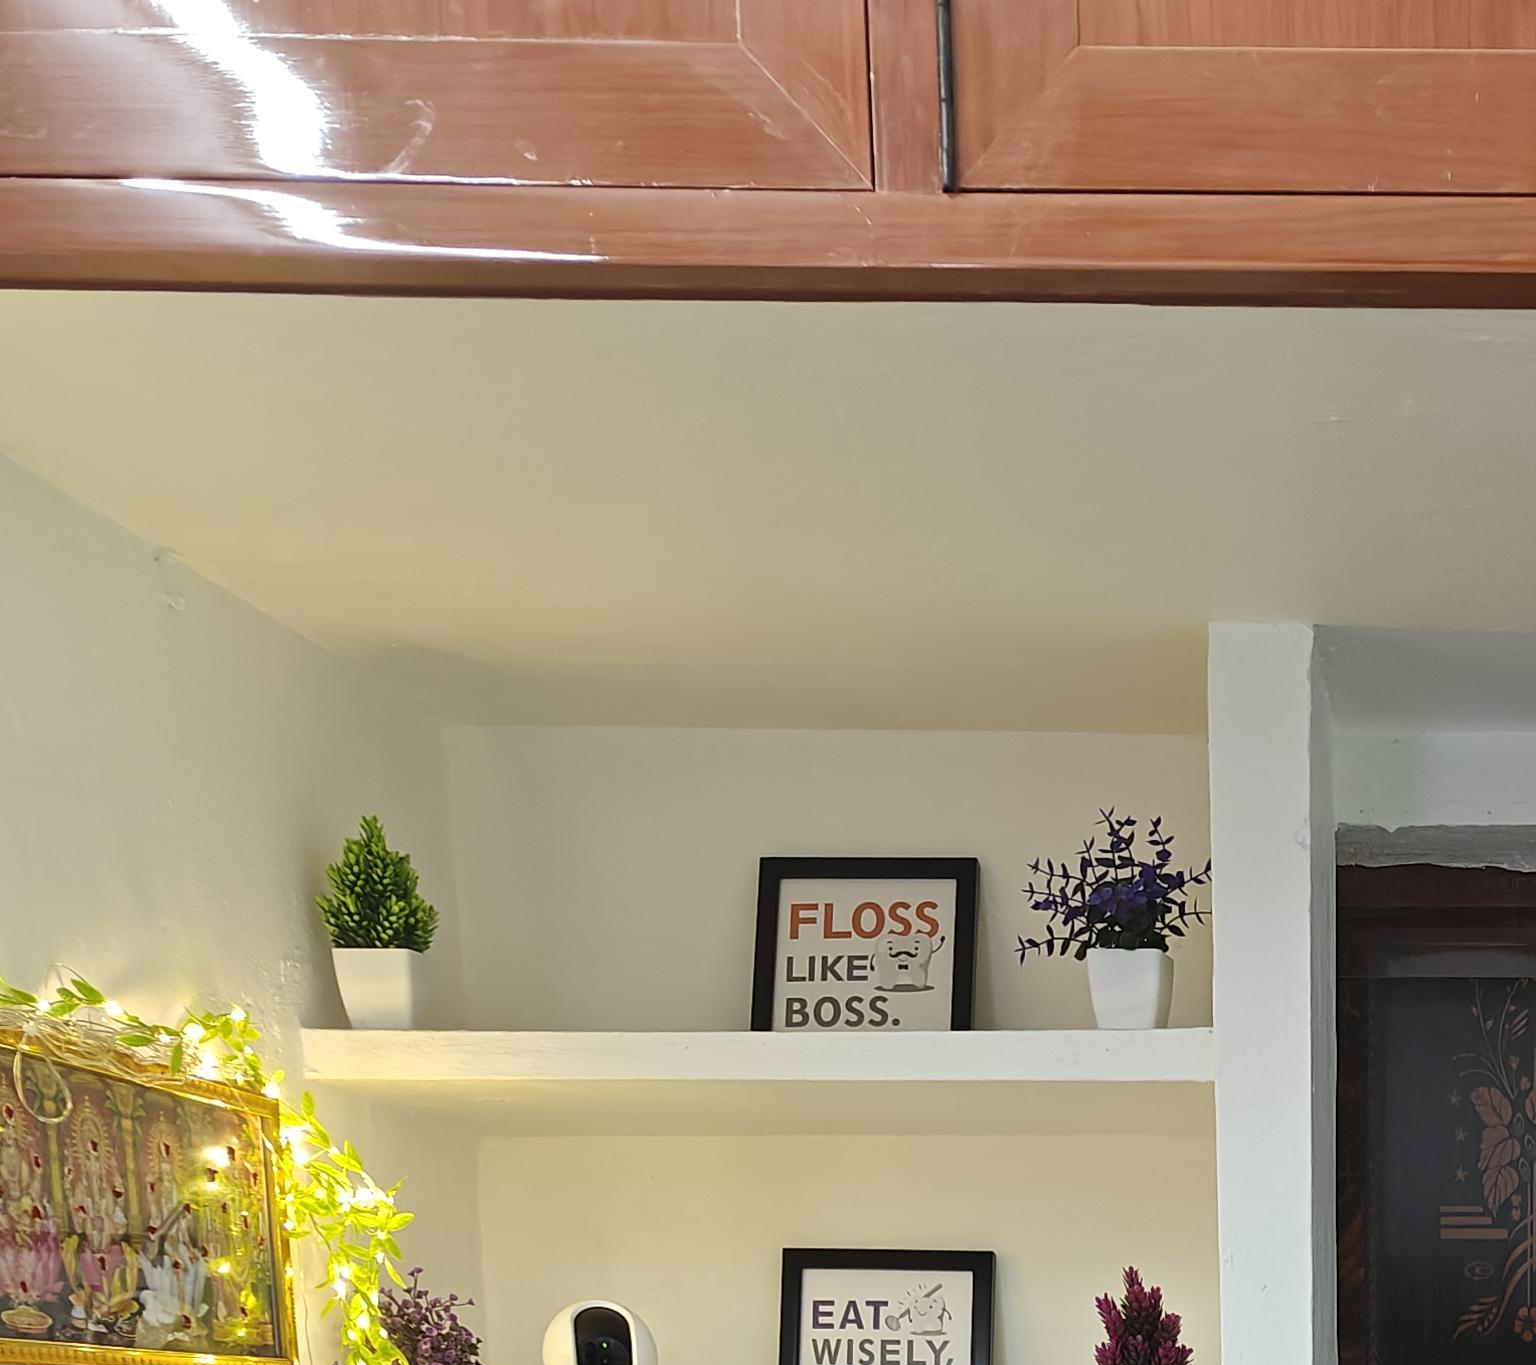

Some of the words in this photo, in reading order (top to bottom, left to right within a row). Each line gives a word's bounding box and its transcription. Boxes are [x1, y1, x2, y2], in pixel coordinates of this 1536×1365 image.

[789, 901, 940, 940] FLOSS
[785, 955, 869, 983] LIKE
[785, 996, 901, 1028] BOSS.
[811, 1300, 889, 1330] EAT
